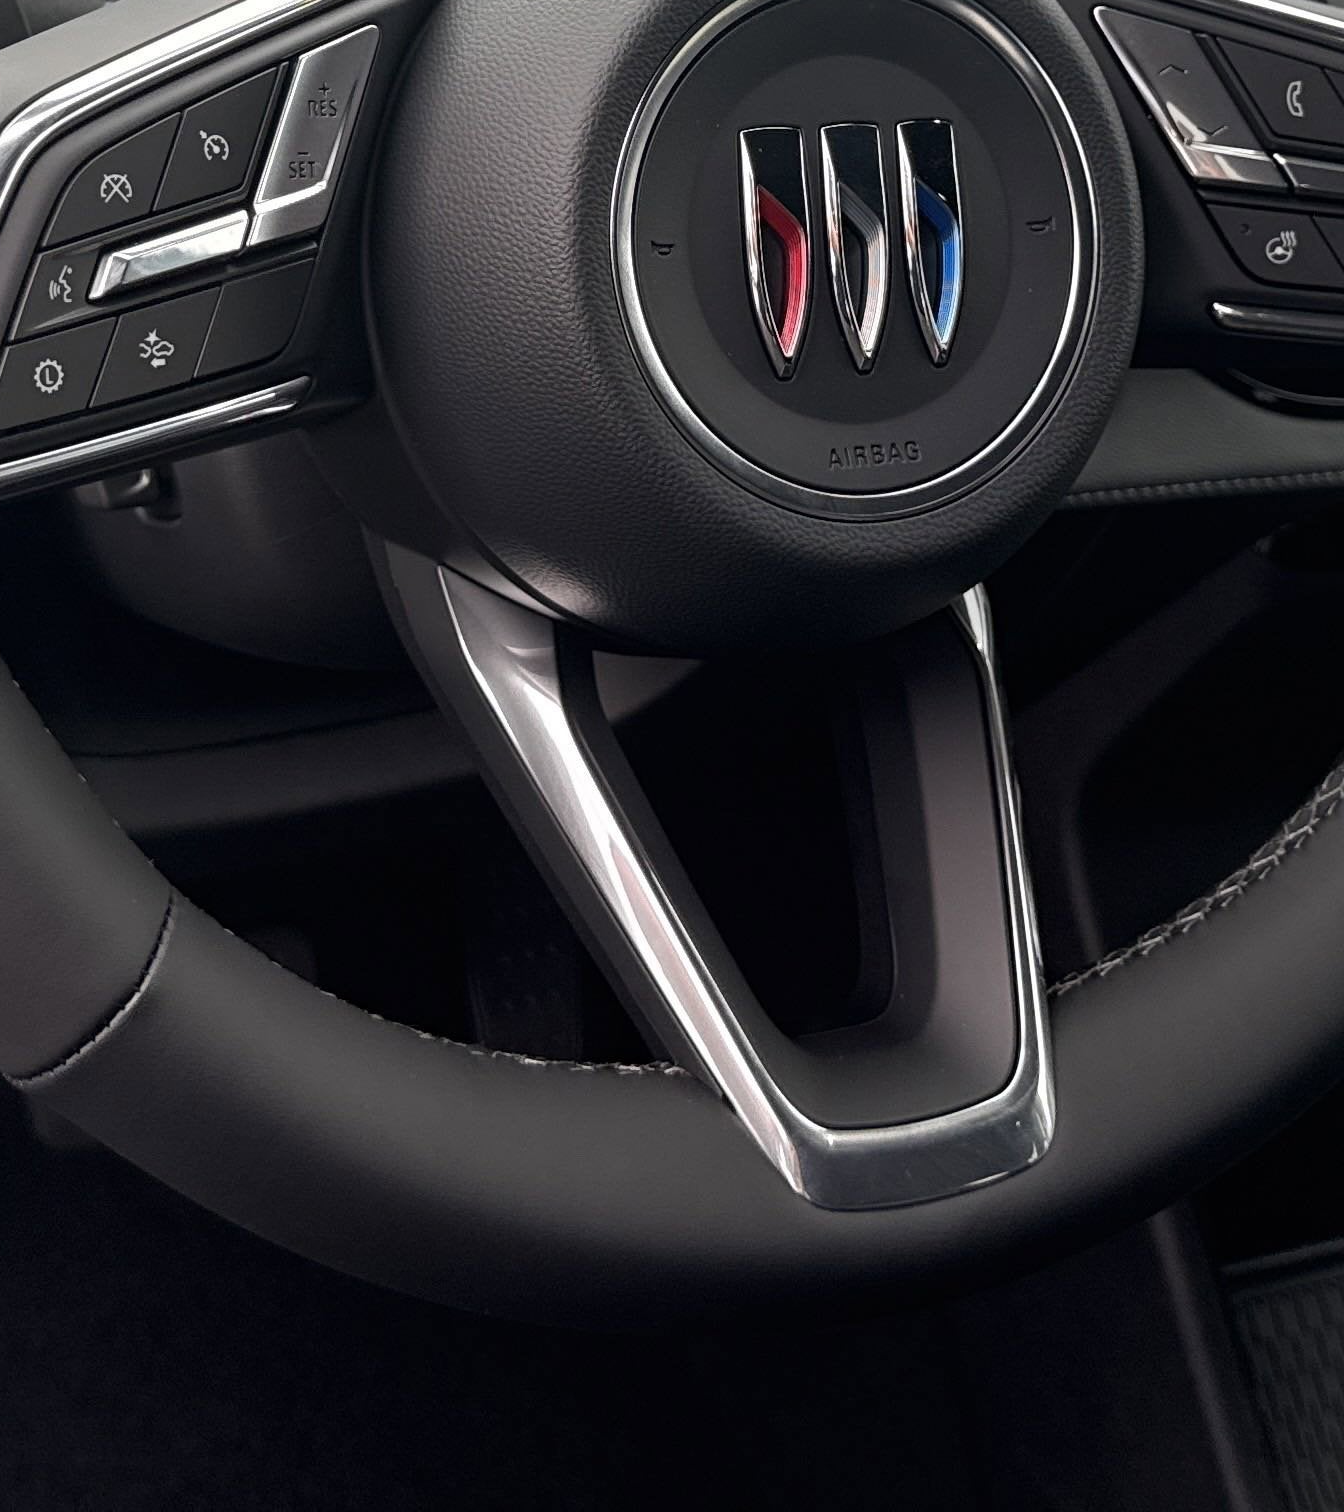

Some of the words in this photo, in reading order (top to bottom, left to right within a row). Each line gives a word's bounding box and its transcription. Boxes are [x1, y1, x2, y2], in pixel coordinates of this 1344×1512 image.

[307, 99, 337, 117] RES
[288, 161, 316, 179] SET
[828, 440, 922, 470] AIRBAG
